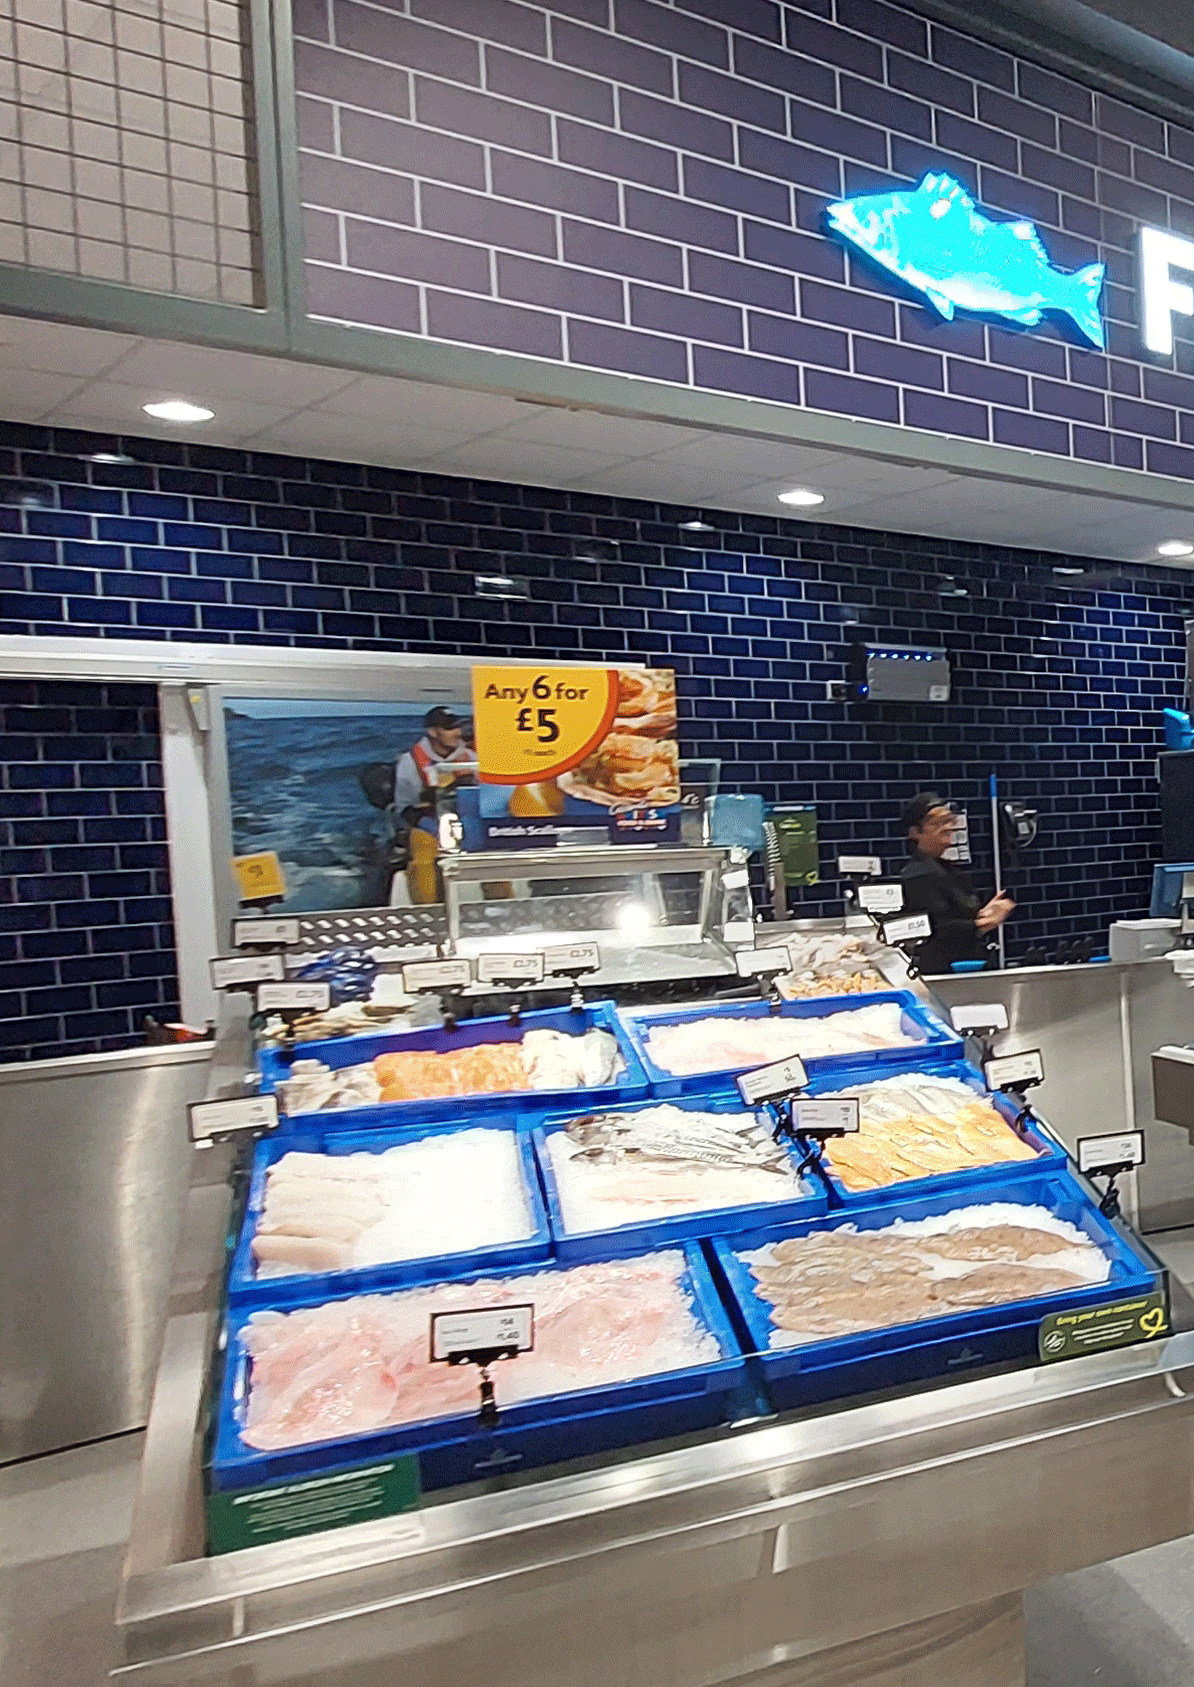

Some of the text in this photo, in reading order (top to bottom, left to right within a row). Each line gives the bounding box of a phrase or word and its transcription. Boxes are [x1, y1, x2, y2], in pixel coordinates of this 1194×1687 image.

[484, 674, 590, 705] Any 6 for
[514, 707, 561, 743] £5
